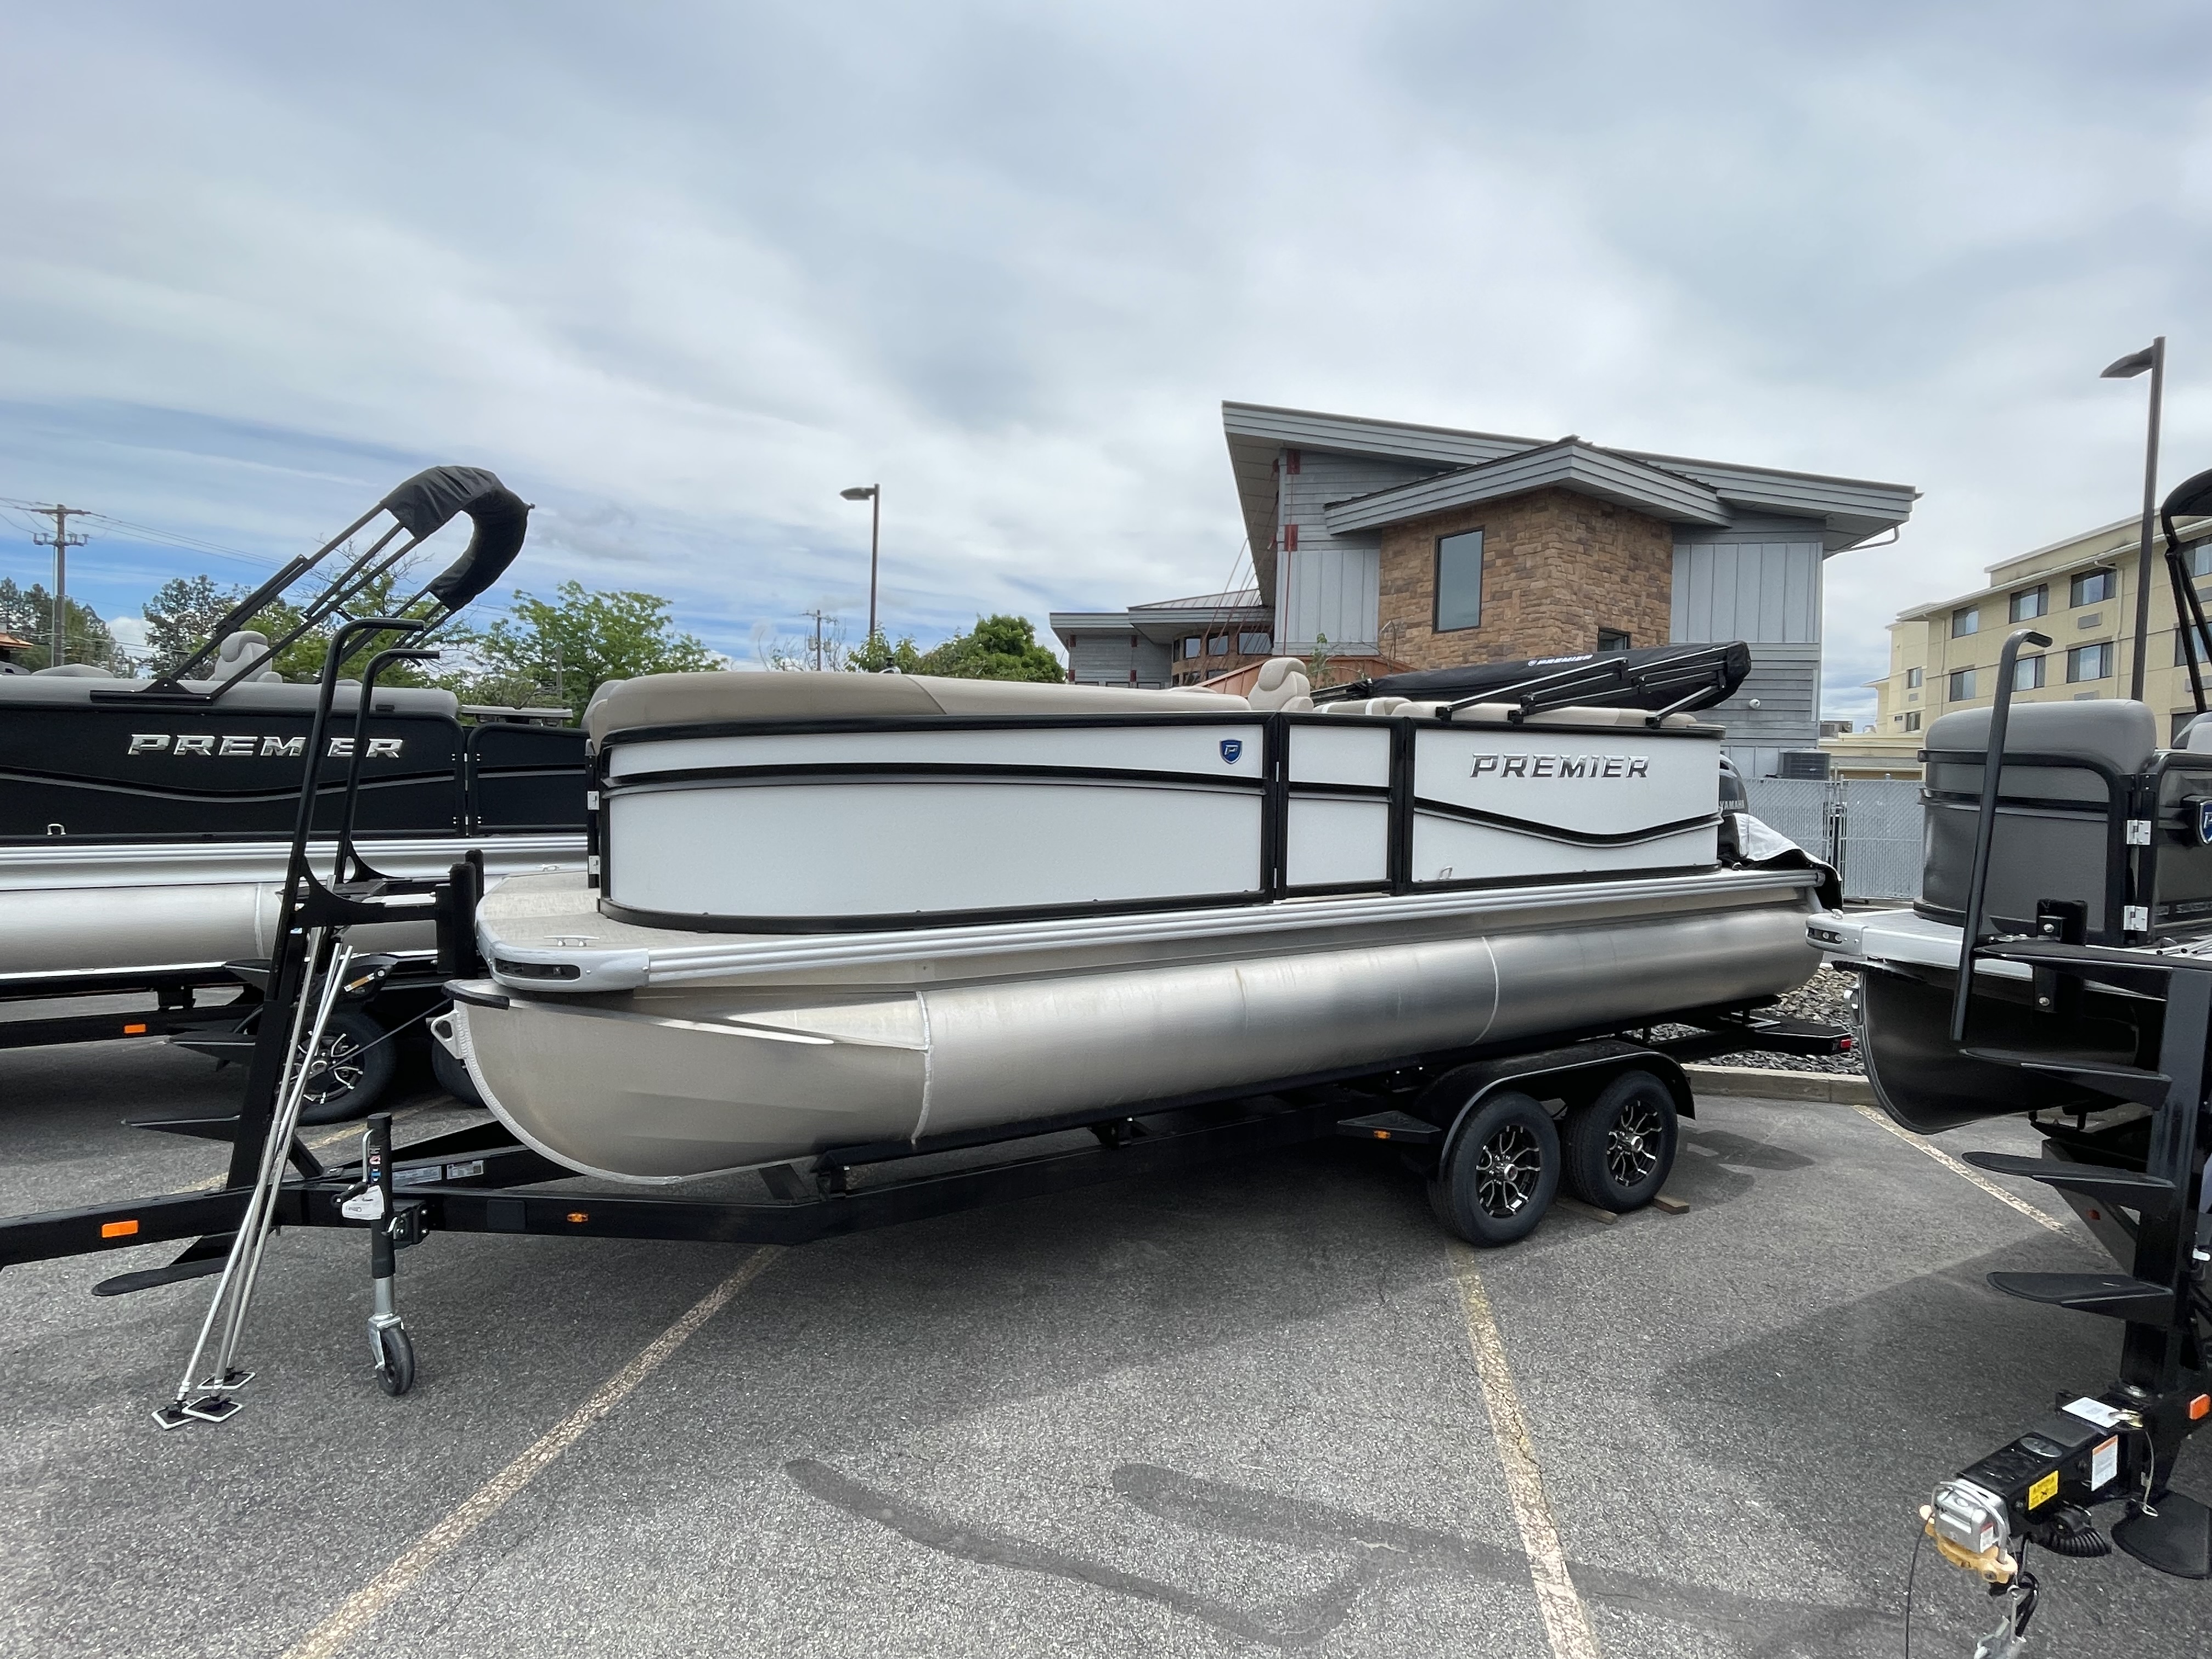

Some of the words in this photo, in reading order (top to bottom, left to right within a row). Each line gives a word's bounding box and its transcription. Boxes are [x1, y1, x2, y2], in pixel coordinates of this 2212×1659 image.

[1536, 654, 1593, 665] PREMIER
[127, 733, 404, 759] PREMER
[1224, 744, 1238, 755] P
[1469, 753, 1650, 778] PREMIER
